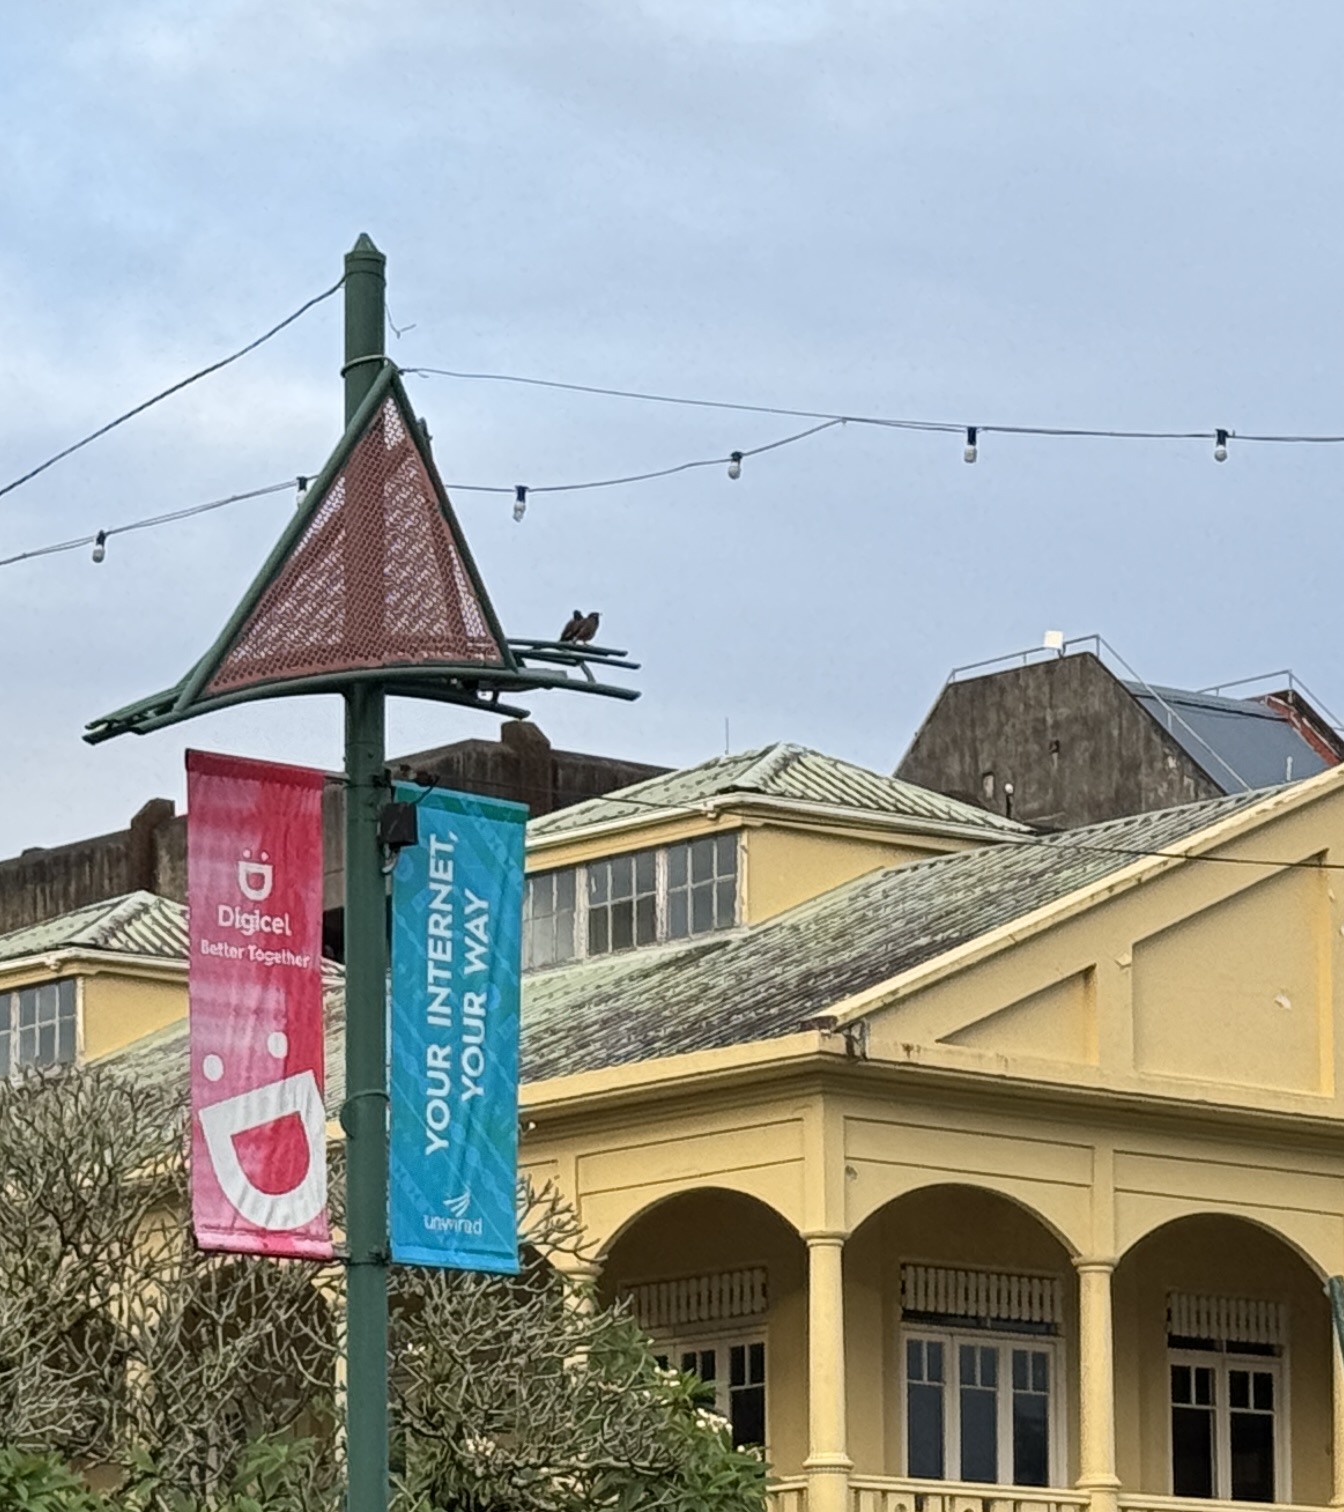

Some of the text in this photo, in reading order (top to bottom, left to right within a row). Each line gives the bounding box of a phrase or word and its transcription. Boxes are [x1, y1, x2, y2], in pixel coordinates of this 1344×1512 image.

[200, 939, 310, 968] Better Together
[218, 904, 292, 936] Digicel
[424, 831, 459, 1156] YOUR INTERNET,
[461, 887, 490, 1102] YOUR WAY
